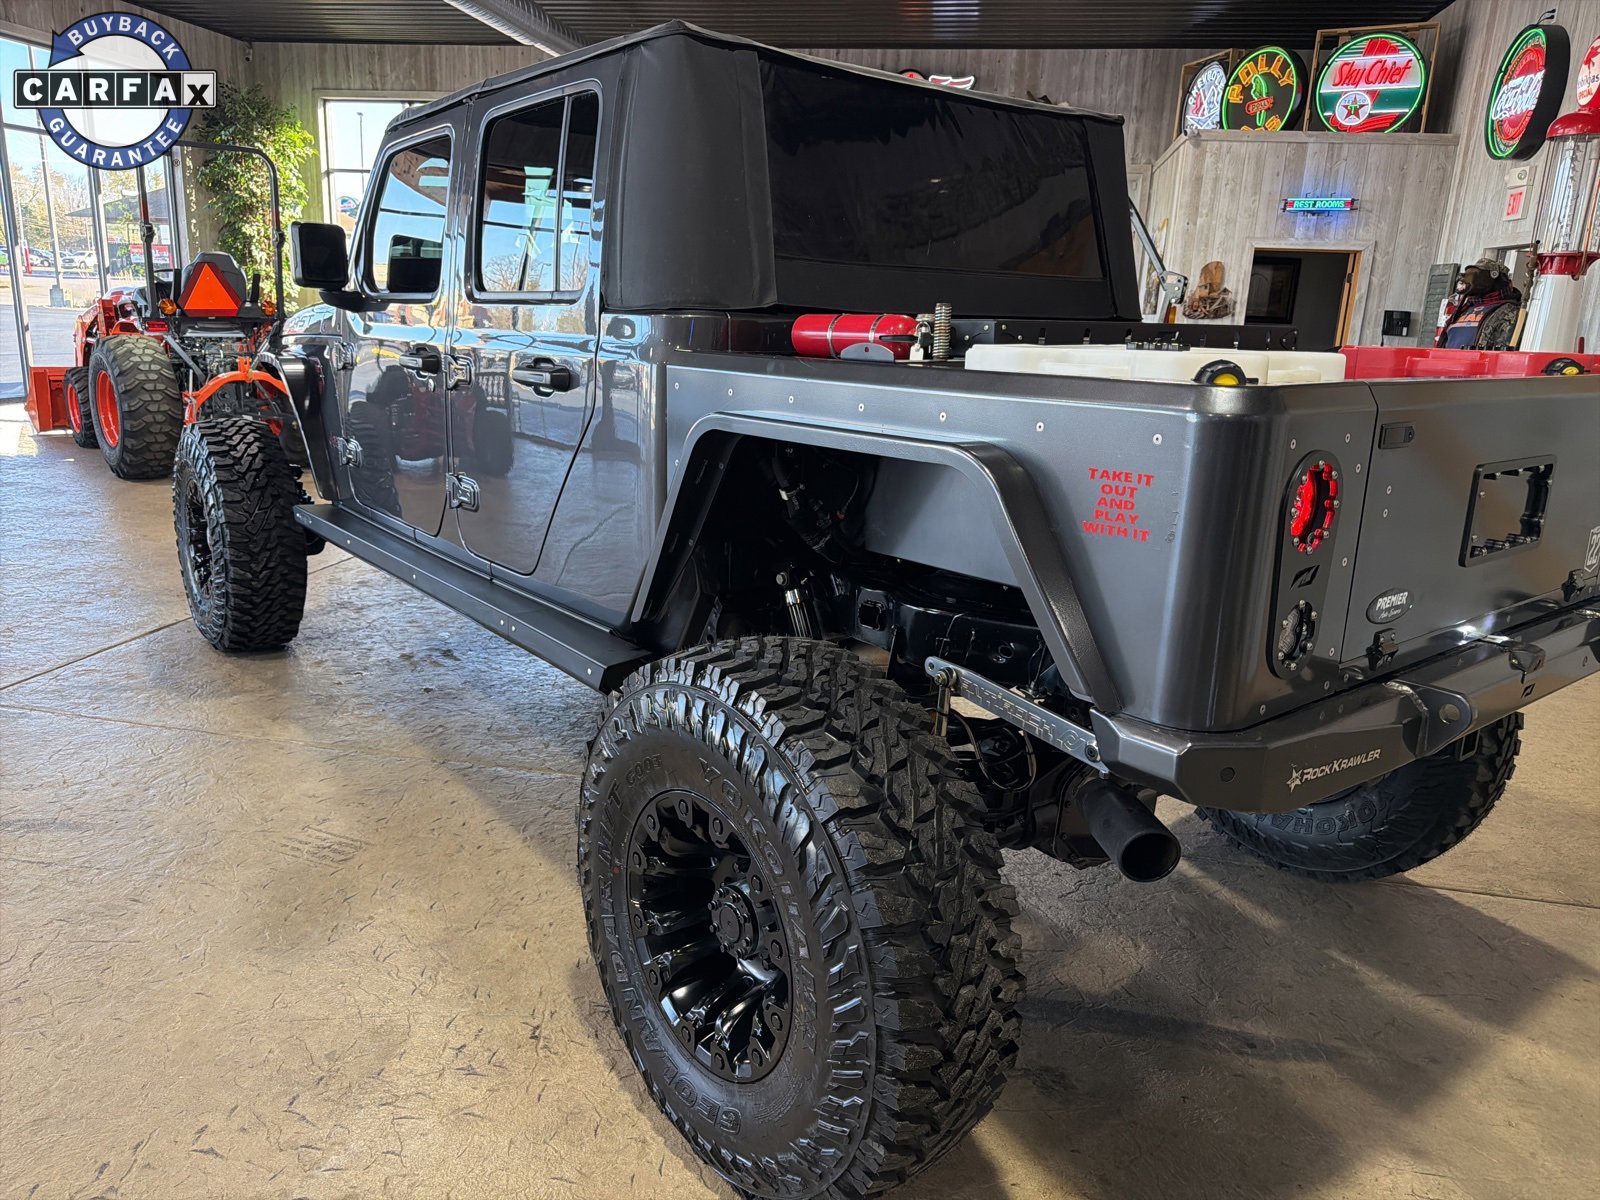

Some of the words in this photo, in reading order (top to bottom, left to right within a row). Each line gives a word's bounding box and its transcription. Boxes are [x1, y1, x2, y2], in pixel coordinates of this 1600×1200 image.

[1228, 54, 1294, 104] POLLY
[1332, 61, 1366, 88] Sky
[1365, 58, 1413, 85] Chief
[1294, 200, 1314, 209] REST
[1315, 200, 1345, 209] ROOMS
[1507, 191, 1523, 217] EXIT
[1088, 467, 1133, 483] TAKE
[1137, 473, 1155, 488] IT
[1100, 484, 1138, 499] OUT
[1096, 496, 1136, 511] AND
[1094, 509, 1139, 526] PLAY
[1082, 521, 1128, 538] WITH
[1132, 529, 1151, 543] IT
[1376, 591, 1408, 611] PREMIER
